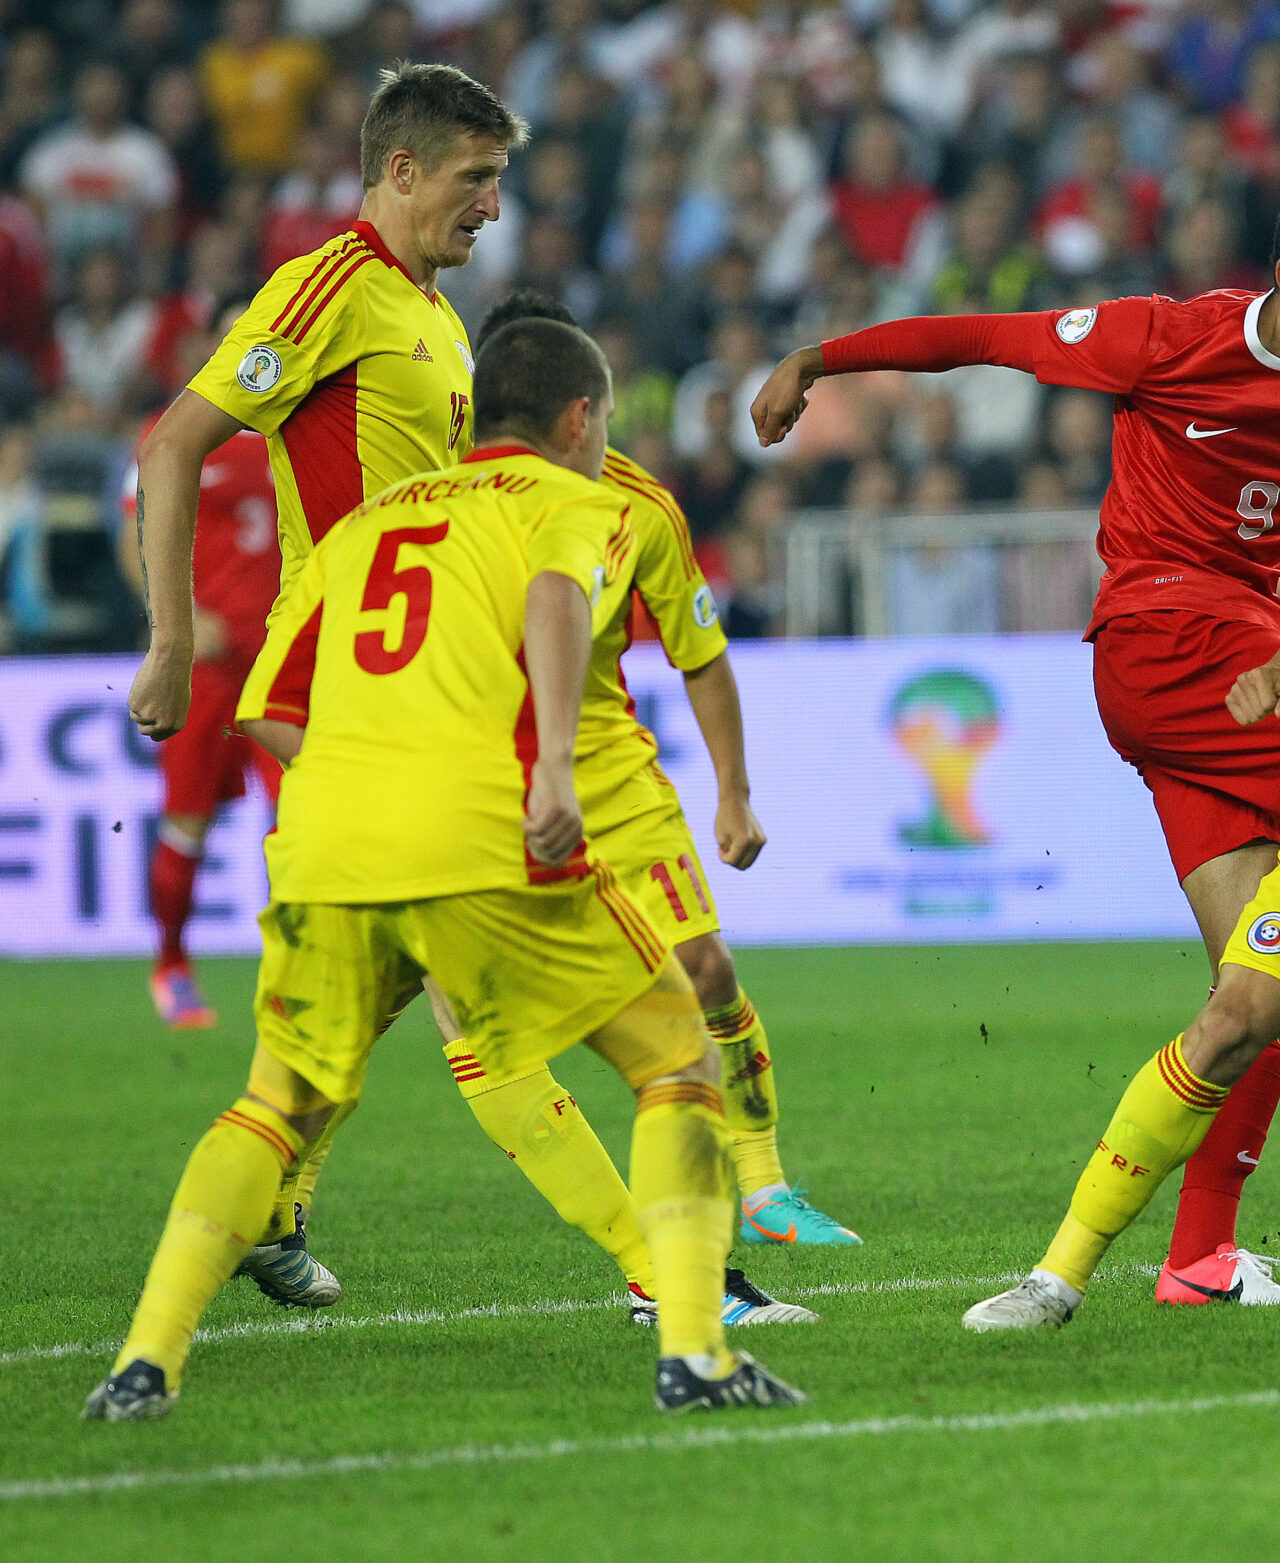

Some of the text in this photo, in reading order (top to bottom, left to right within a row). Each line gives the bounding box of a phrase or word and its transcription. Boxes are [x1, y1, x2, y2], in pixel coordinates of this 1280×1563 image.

[411, 353, 434, 363] adidas
[448, 391, 469, 451] 15
[346, 472, 539, 525] URCEANU
[1236, 480, 1280, 540] 9
[354, 519, 450, 675] 5
[1155, 575, 1184, 584] DRI-FIT
[651, 853, 710, 923] 11
